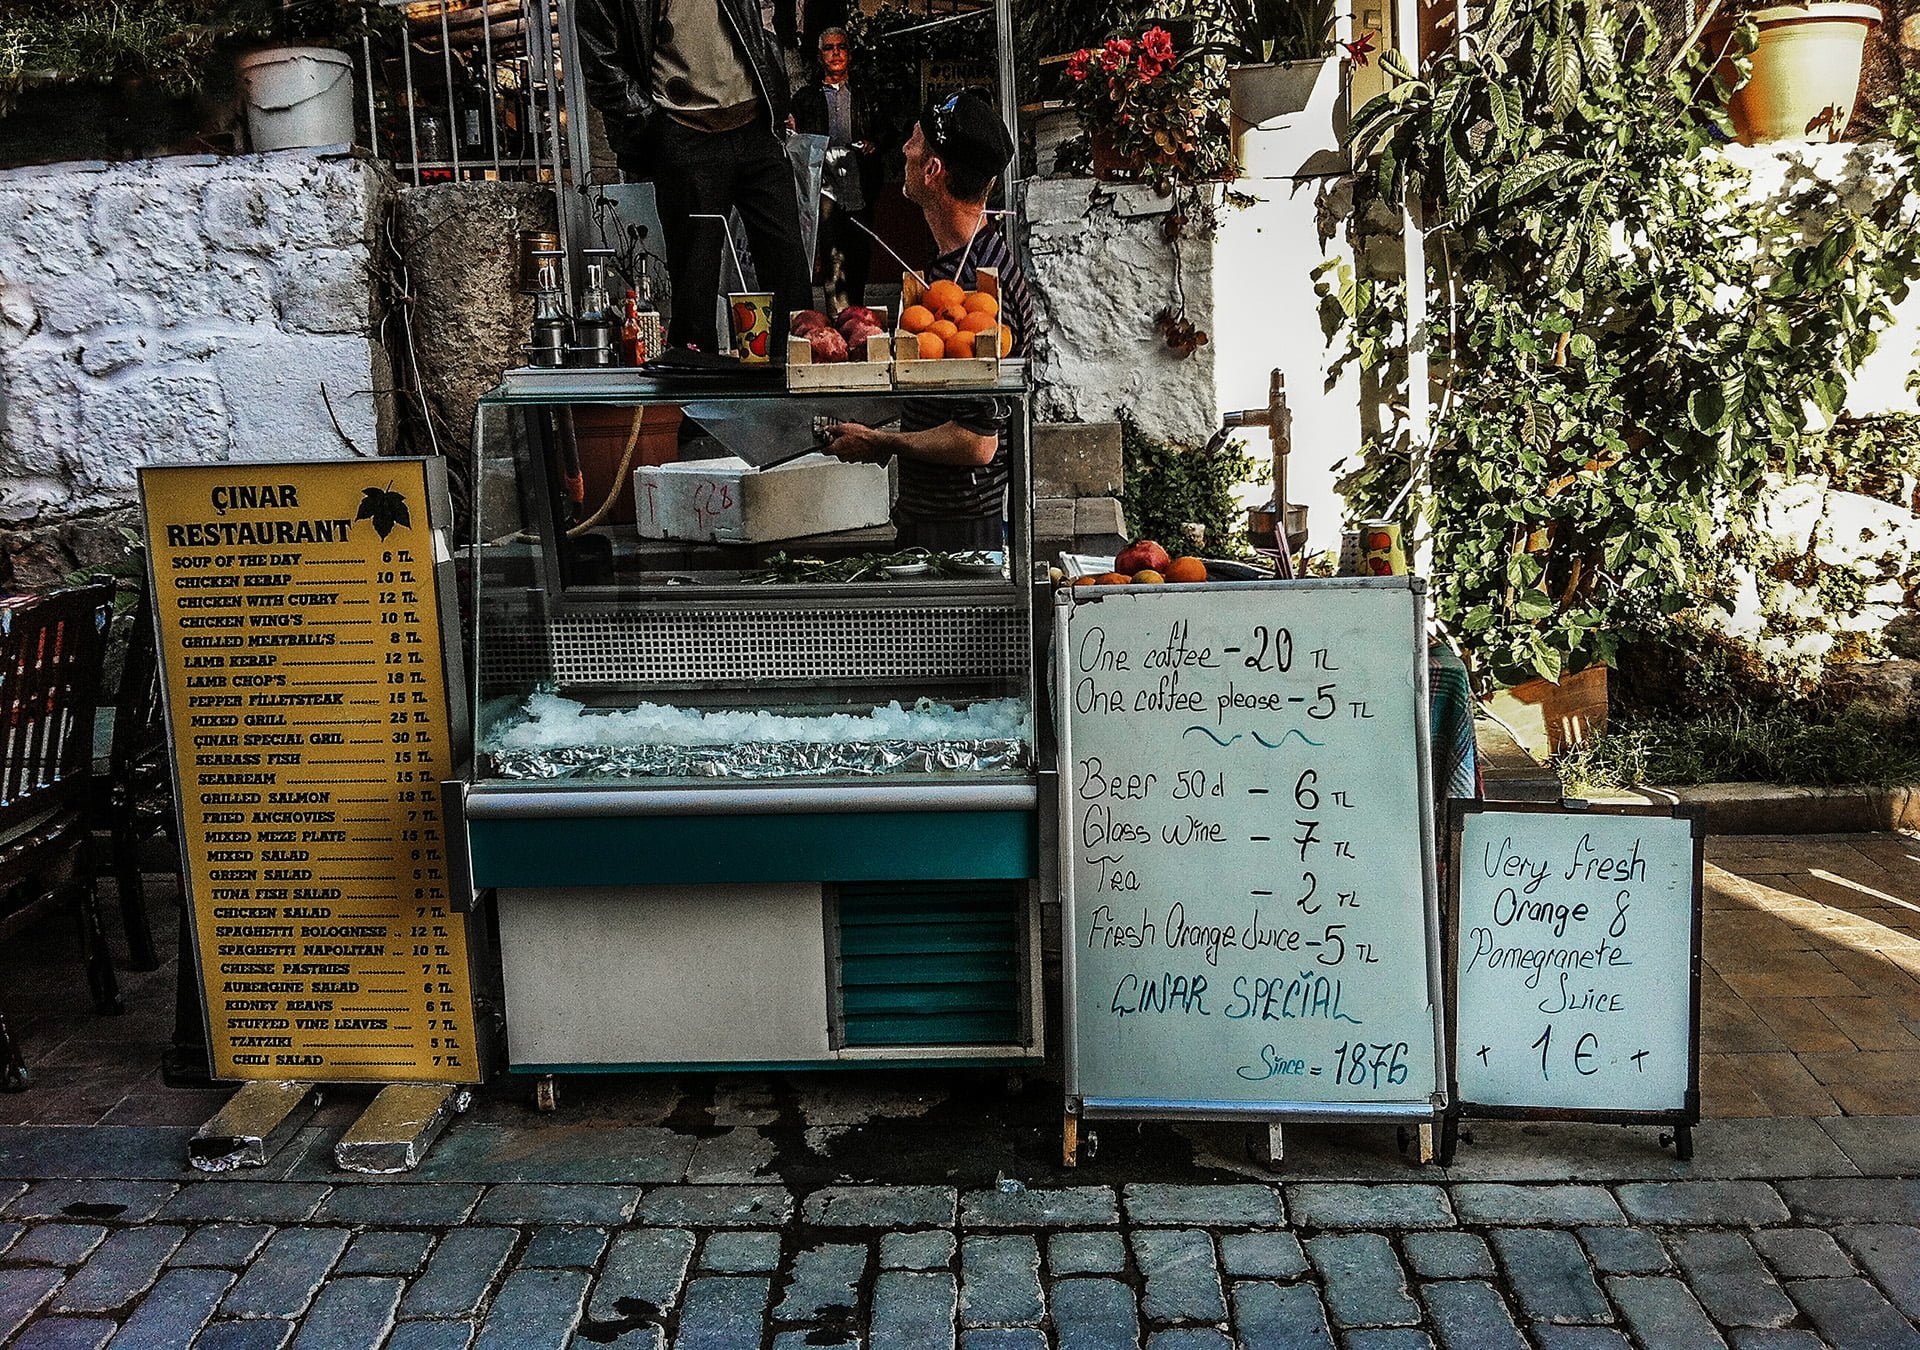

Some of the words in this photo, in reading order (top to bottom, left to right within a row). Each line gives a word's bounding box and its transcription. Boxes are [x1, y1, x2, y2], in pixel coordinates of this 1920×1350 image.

[211, 484, 299, 515] ÇINAR
[166, 519, 352, 548] RESTAURANT
[172, 556, 211, 569] SOUP
[215, 554, 235, 568] OF
[238, 554, 267, 567] THE
[270, 553, 302, 566] DAY
[383, 550, 392, 564] 6
[175, 575, 240, 589] CHICKEN
[244, 574, 291, 587] KEBAP
[377, 571, 393, 584] 10
[177, 595, 242, 609] CHICKEN
[246, 594, 284, 607] WITH
[288, 593, 339, 606] CURRY
[379, 591, 395, 604] 12
[179, 615, 244, 629] CHICKEN
[249, 614, 303, 627] WING'S
[381, 611, 397, 624] 10
[182, 635, 244, 649] GRILLED
[391, 631, 400, 644] 8
[1079, 626, 1130, 673] One
[1144, 619, 1221, 669] coffee
[1310, 649, 1339, 671] TL
[184, 656, 224, 669] LAMB
[229, 654, 277, 668] KEBAP
[385, 652, 401, 665] 12
[186, 675, 227, 688] LAMB
[232, 674, 286, 688] CHOP'S
[387, 672, 404, 684] 18
[189, 695, 242, 708] PEPPER
[389, 691, 405, 704] 15
[1076, 676, 1126, 715] One
[1134, 670, 1209, 714] coffee
[1217, 682, 1283, 725] please
[1349, 702, 1375, 719] TL
[191, 714, 238, 727] MIXED
[244, 714, 287, 727] GRILL
[390, 711, 407, 724] 25
[194, 734, 238, 750] ÇINAR
[244, 733, 304, 746] SPECIAL
[392, 731, 409, 744] 30
[267, 753, 301, 766] FISH
[395, 751, 411, 764] 15
[198, 773, 276, 786] SEABREAM
[397, 770, 413, 783] 15
[1078, 757, 1157, 800] Beer
[1294, 769, 1319, 810] 6
[1331, 791, 1354, 808] TL
[200, 792, 261, 805] GRILLED
[268, 791, 330, 804] SALMON
[398, 790, 415, 803] 18
[202, 812, 246, 824] FRIED
[251, 811, 335, 824] ANCHOVIES
[408, 810, 417, 823] 7
[205, 831, 251, 843] MIXED
[257, 830, 296, 843] MEZE
[302, 830, 346, 843] PLATE
[401, 829, 420, 842] 15
[1083, 804, 1151, 848] Glass
[1293, 819, 1320, 861] 7
[1334, 841, 1355, 859] TL
[207, 850, 253, 863] MIXED
[261, 850, 309, 862] SALAD
[1484, 836, 1552, 894] Very
[209, 869, 257, 881] GREEN
[264, 869, 312, 881] SALAD
[1086, 855, 1141, 893] Tea
[1297, 871, 1322, 915] 2
[1337, 891, 1361, 908] TL
[211, 888, 250, 900] TUNA
[255, 888, 289, 900] FISH
[293, 888, 341, 900] SALAD
[214, 907, 277, 919] CHICKEN
[283, 907, 331, 919] SALAD
[416, 906, 425, 919] 7
[1494, 887, 1589, 938] Orange
[216, 925, 294, 938] SPAGHETTI
[301, 925, 387, 938] BOLOGNESE
[410, 926, 427, 938] 12
[1088, 905, 1155, 949] Fresh
[1165, 902, 1237, 966] Orange
[1242, 909, 1300, 951] Juice
[1356, 944, 1379, 963] TL
[218, 944, 296, 956] SPAGHETTI
[304, 944, 385, 957] NAPOLITAN
[413, 944, 428, 957] 10
[221, 963, 275, 975] CHEESE
[283, 963, 350, 975] PASTRIES
[422, 963, 431, 975] 7
[222, 981, 303, 993] AUBERGINE
[312, 981, 359, 994] SALAD
[424, 982, 432, 994] 6
[225, 999, 278, 1011] KIDNEY
[286, 1000, 333, 1012] BEANS
[426, 1000, 434, 1012] 6
[227, 1018, 289, 1030] STUFFED
[295, 1018, 328, 1030] VINE
[335, 1018, 387, 1030] LEAVES
[429, 1019, 436, 1031] 7
[230, 1036, 292, 1048] TZATZIKI
[431, 1037, 438, 1049] 5
[232, 1054, 269, 1066] CHILI
[276, 1054, 323, 1066] SALAD
[433, 1055, 441, 1067] 7
[1531, 1024, 1552, 1081] 1
[1236, 1044, 1305, 1081] Since
[1335, 1041, 1409, 1089] 1876
